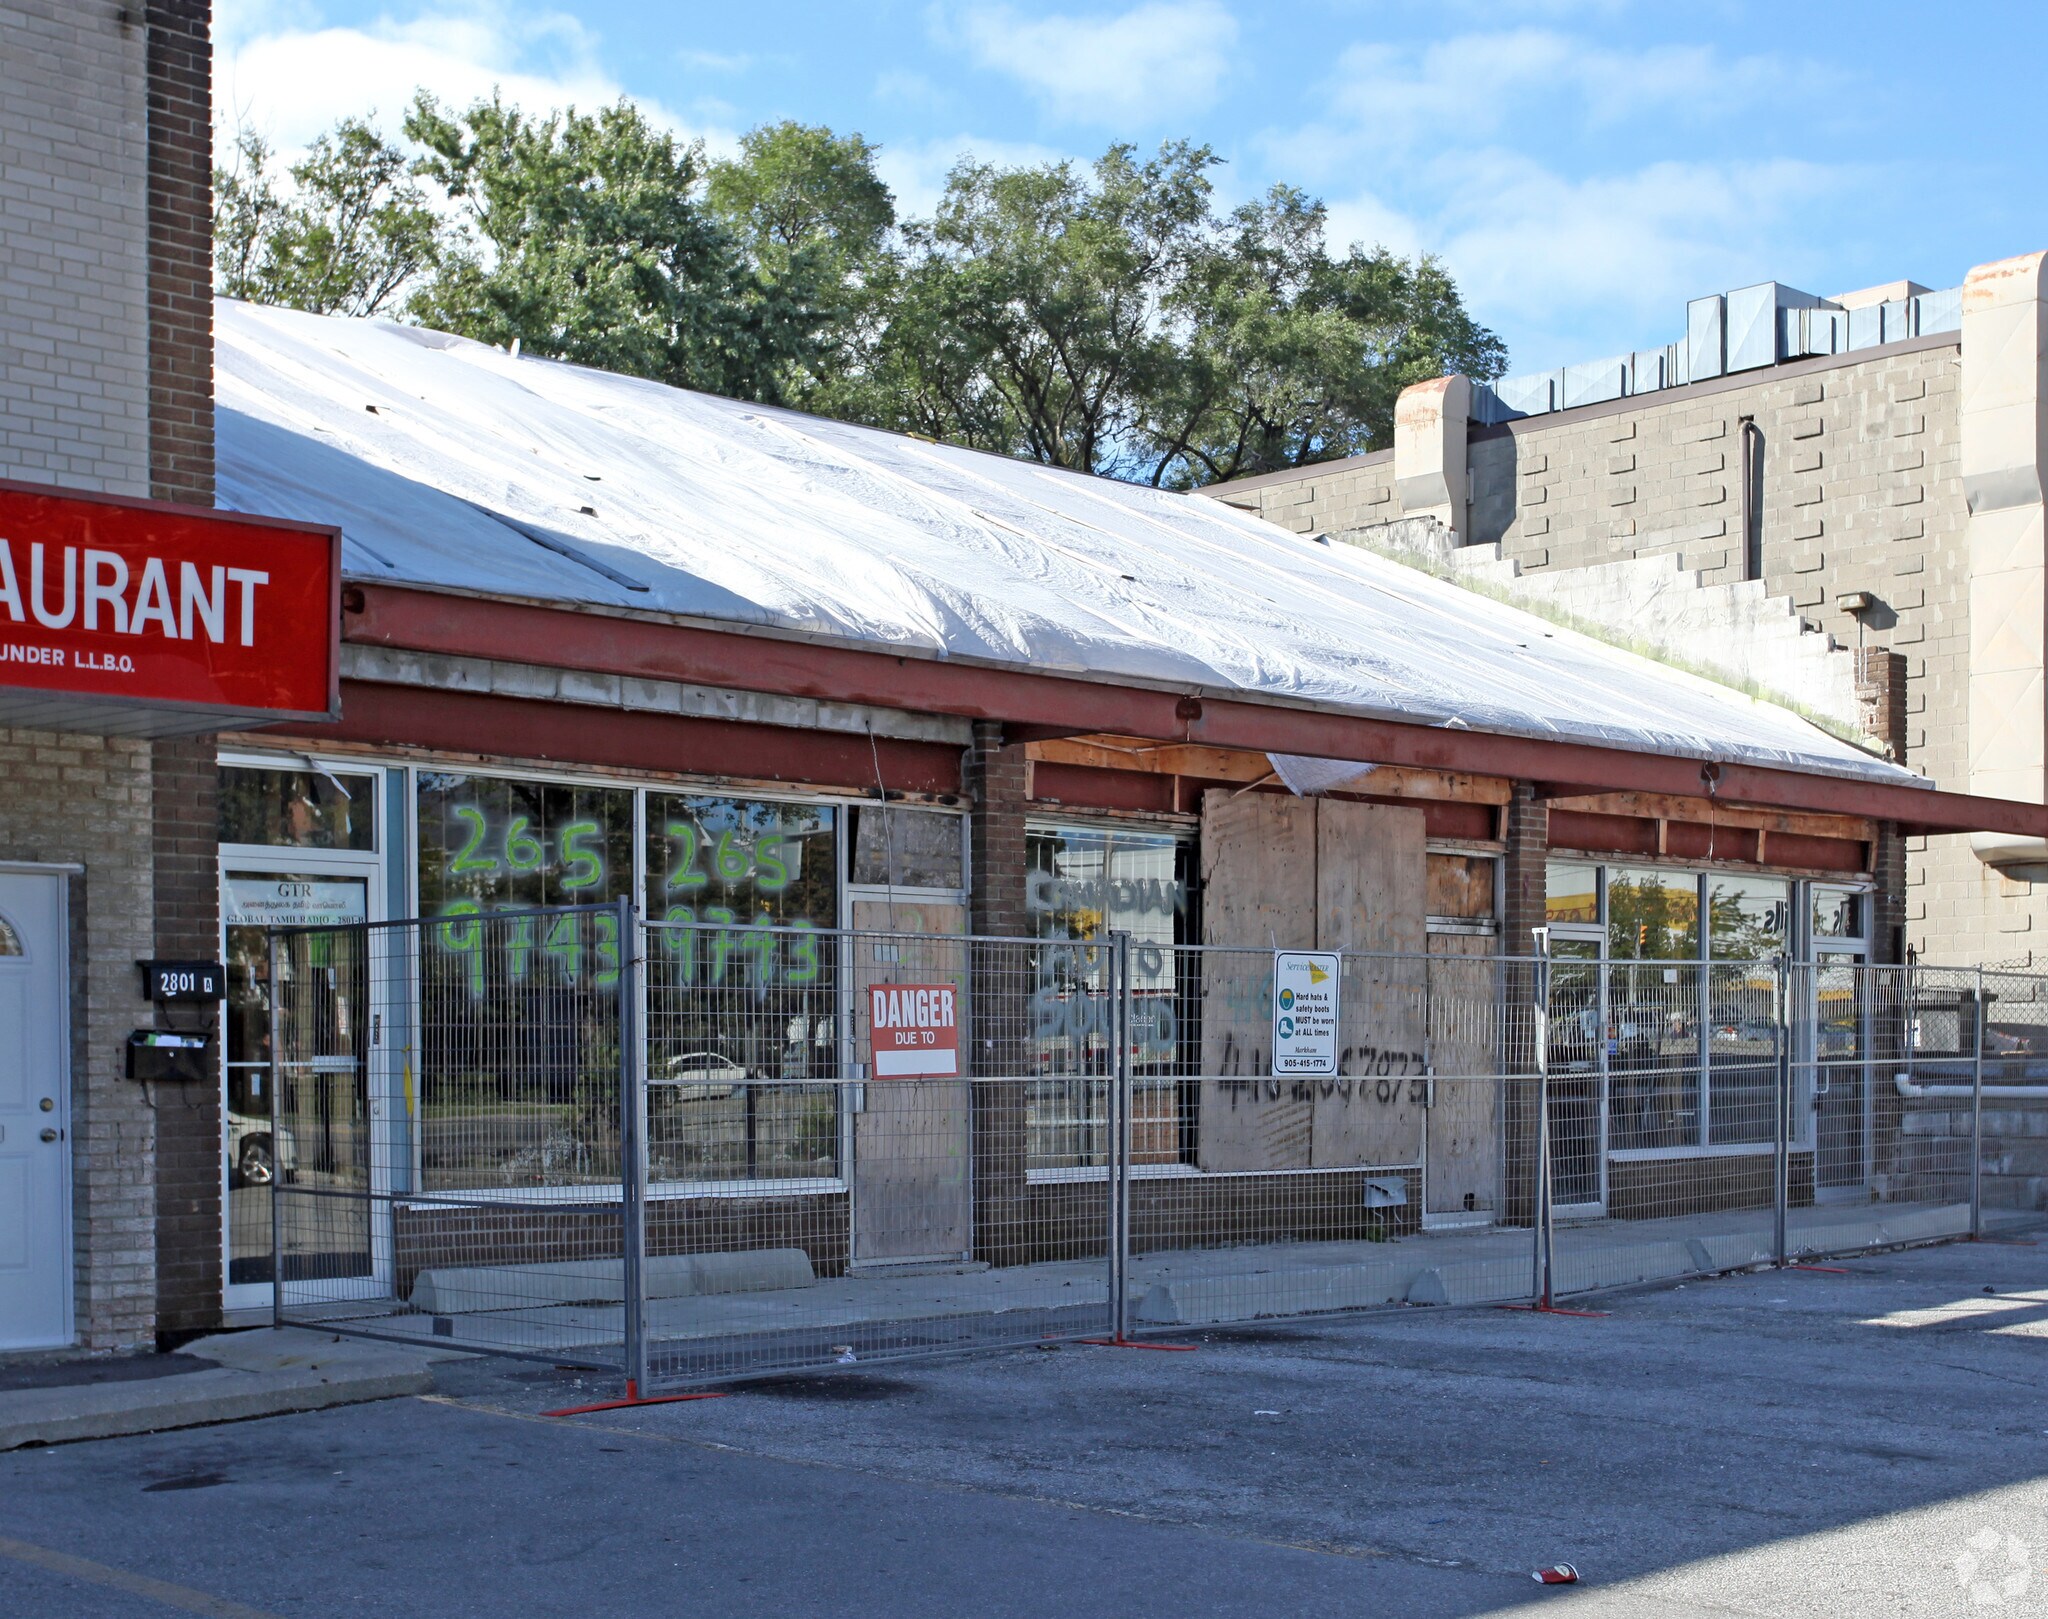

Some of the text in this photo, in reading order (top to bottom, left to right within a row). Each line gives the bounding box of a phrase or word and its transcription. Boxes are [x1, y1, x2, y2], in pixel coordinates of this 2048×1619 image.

[448, 806, 601, 889] 265
[667, 823, 789, 889] 265
[277, 883, 312, 898] GTR
[226, 914, 267, 924] GLOBAL
[270, 914, 299, 924] TAMIL
[299, 915, 330, 924] RADIO
[440, 901, 620, 997] 9743
[664, 904, 819, 990] 9743
[160, 972, 195, 992] 2801
[1296, 992, 1329, 1001] Hard hats &
[873, 989, 955, 1028] DANGER
[1295, 1004, 1330, 1014] safety boots
[1295, 1016, 1312, 1024] MUST
[1312, 1017, 1320, 1025] be
[895, 1031, 935, 1045] DUE TO
[1302, 1028, 1313, 1036] ALL
[1314, 1029, 1330, 1037] times
[1284, 1059, 1327, 1067] 905-415-1774
